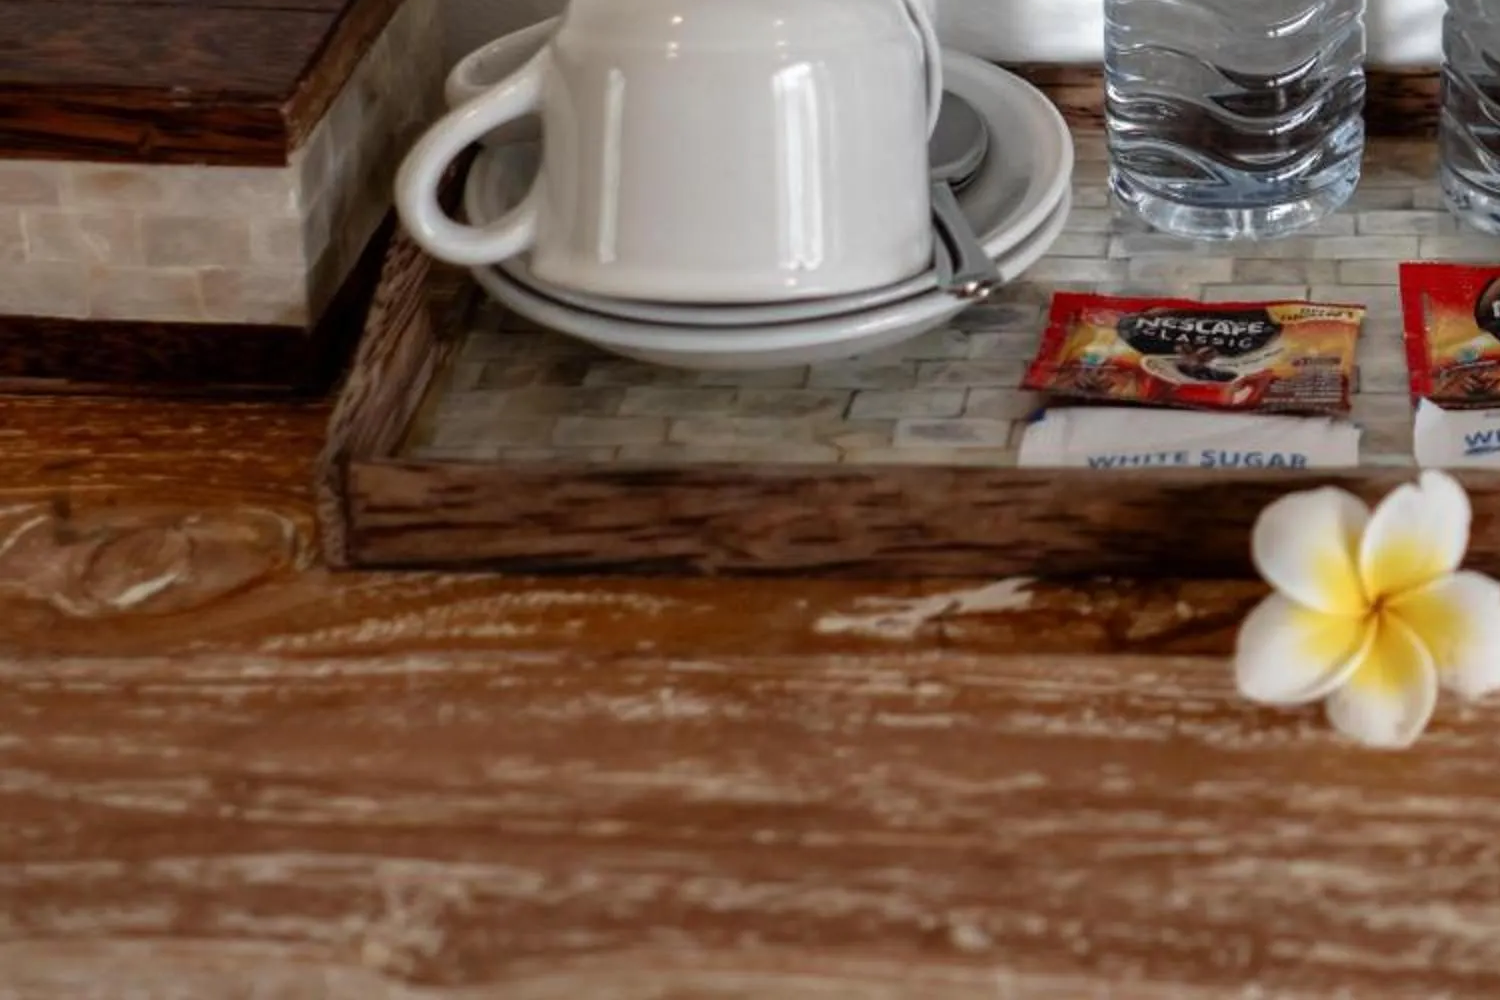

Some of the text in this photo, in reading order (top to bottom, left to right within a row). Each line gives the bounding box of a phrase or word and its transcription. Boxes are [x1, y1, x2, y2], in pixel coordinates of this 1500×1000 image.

[1141, 327, 1254, 349] CLASSIC
[1086, 450, 1310, 470] WHITE SUGAR
